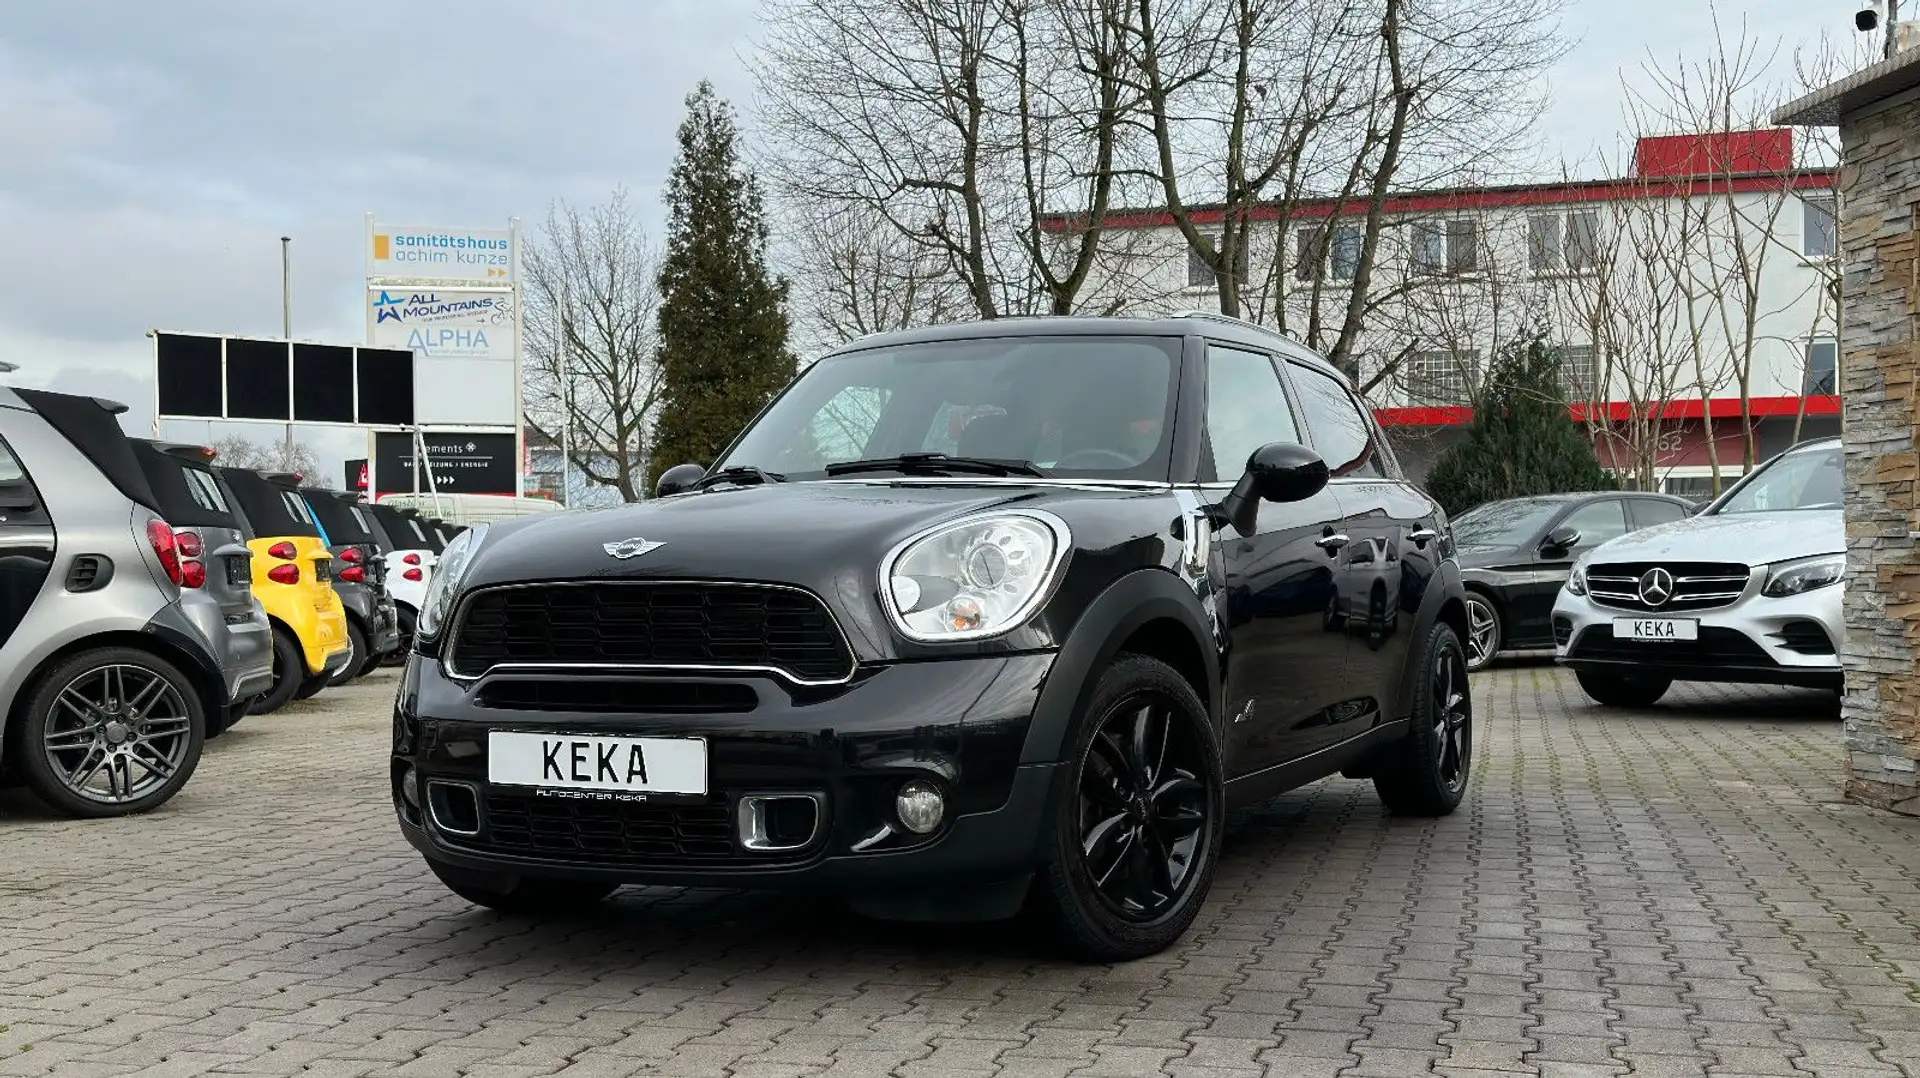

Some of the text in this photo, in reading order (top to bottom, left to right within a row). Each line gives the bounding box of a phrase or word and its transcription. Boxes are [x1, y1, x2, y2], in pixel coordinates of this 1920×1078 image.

[395, 234, 508, 250] sanitätshaus
[395, 249, 508, 265] achim kunze
[408, 293, 441, 306] ALL
[403, 298, 493, 318] MOUNTAINS
[407, 328, 490, 357] ALPHA
[425, 444, 463, 453] ements
[1634, 621, 1675, 637] KEKA
[542, 740, 648, 784] KEKA
[615, 794, 647, 802] KEKA
